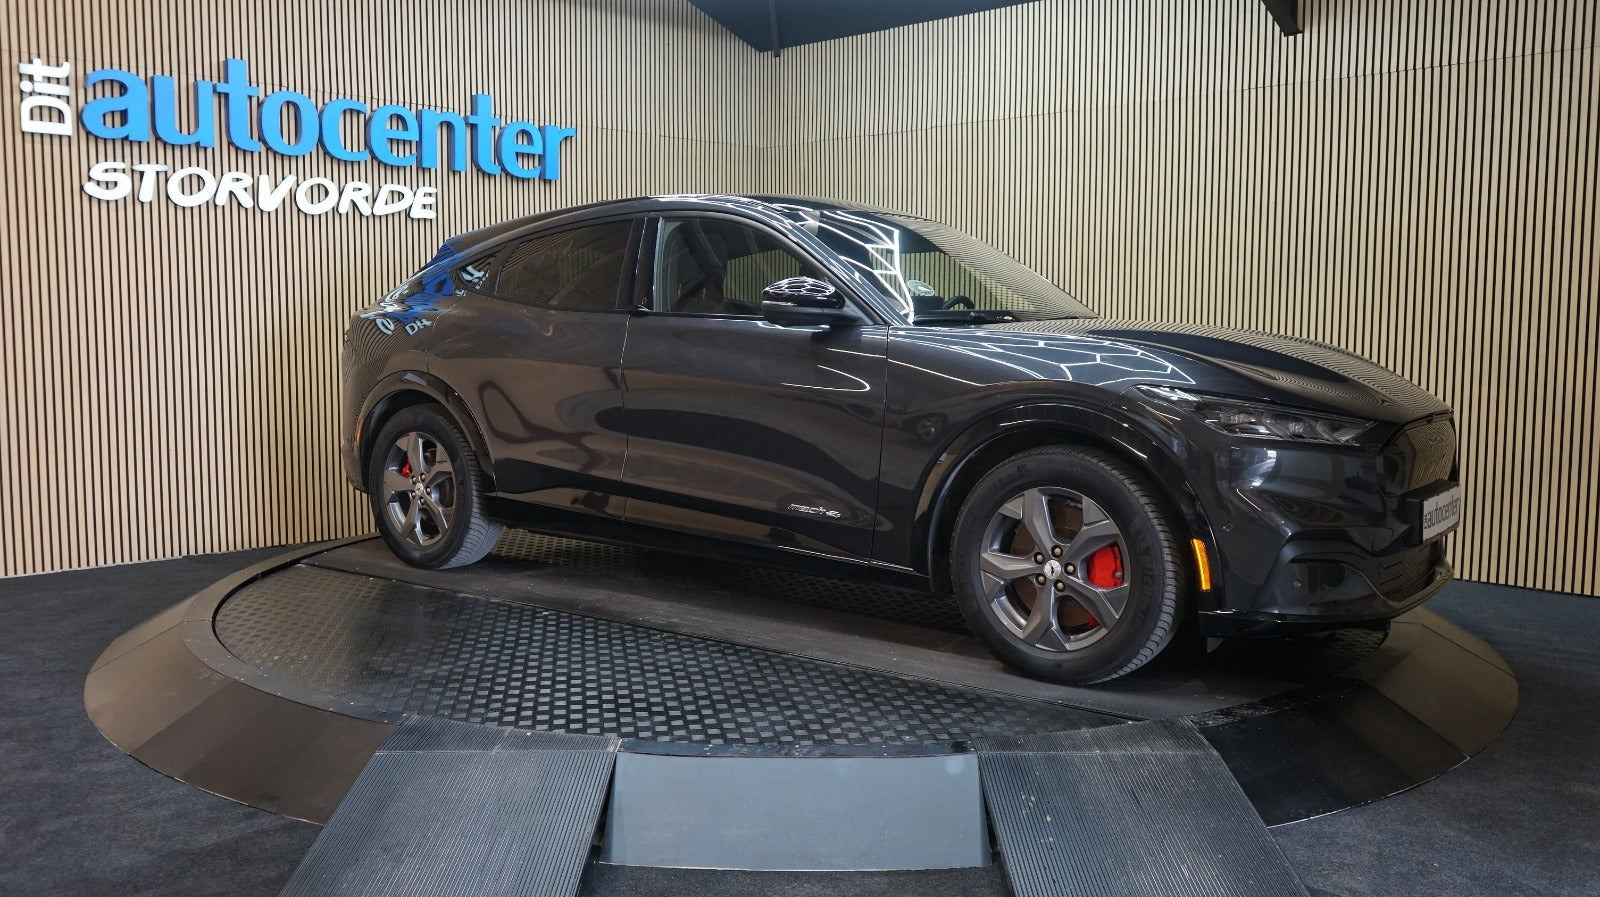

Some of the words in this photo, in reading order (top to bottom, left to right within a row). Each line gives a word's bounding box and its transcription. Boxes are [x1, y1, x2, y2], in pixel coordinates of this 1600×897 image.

[19, 58, 73, 137] Dit
[80, 58, 577, 181] autocenter
[83, 161, 438, 220] STORVORDE
[1428, 494, 1459, 528] autocenter
